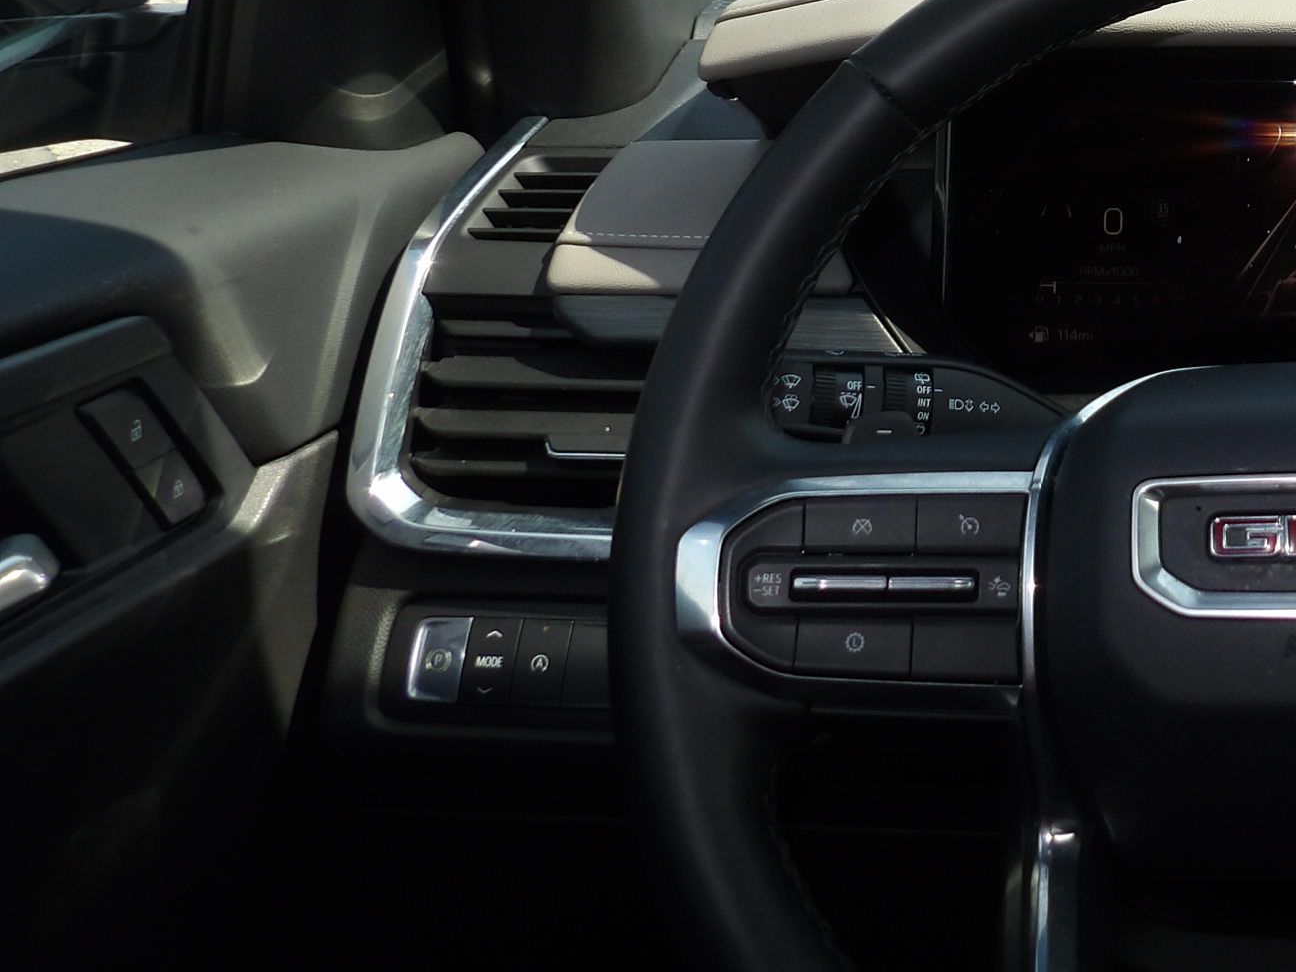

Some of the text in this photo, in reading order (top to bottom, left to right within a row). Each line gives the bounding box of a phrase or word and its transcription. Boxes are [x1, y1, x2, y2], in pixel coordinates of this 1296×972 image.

[1103, 207, 1123, 235] 0
[847, 381, 862, 391] OFF
[916, 385, 932, 395] OFF
[917, 398, 931, 408] INT
[917, 411, 929, 421] ON
[474, 655, 505, 669] MODE
